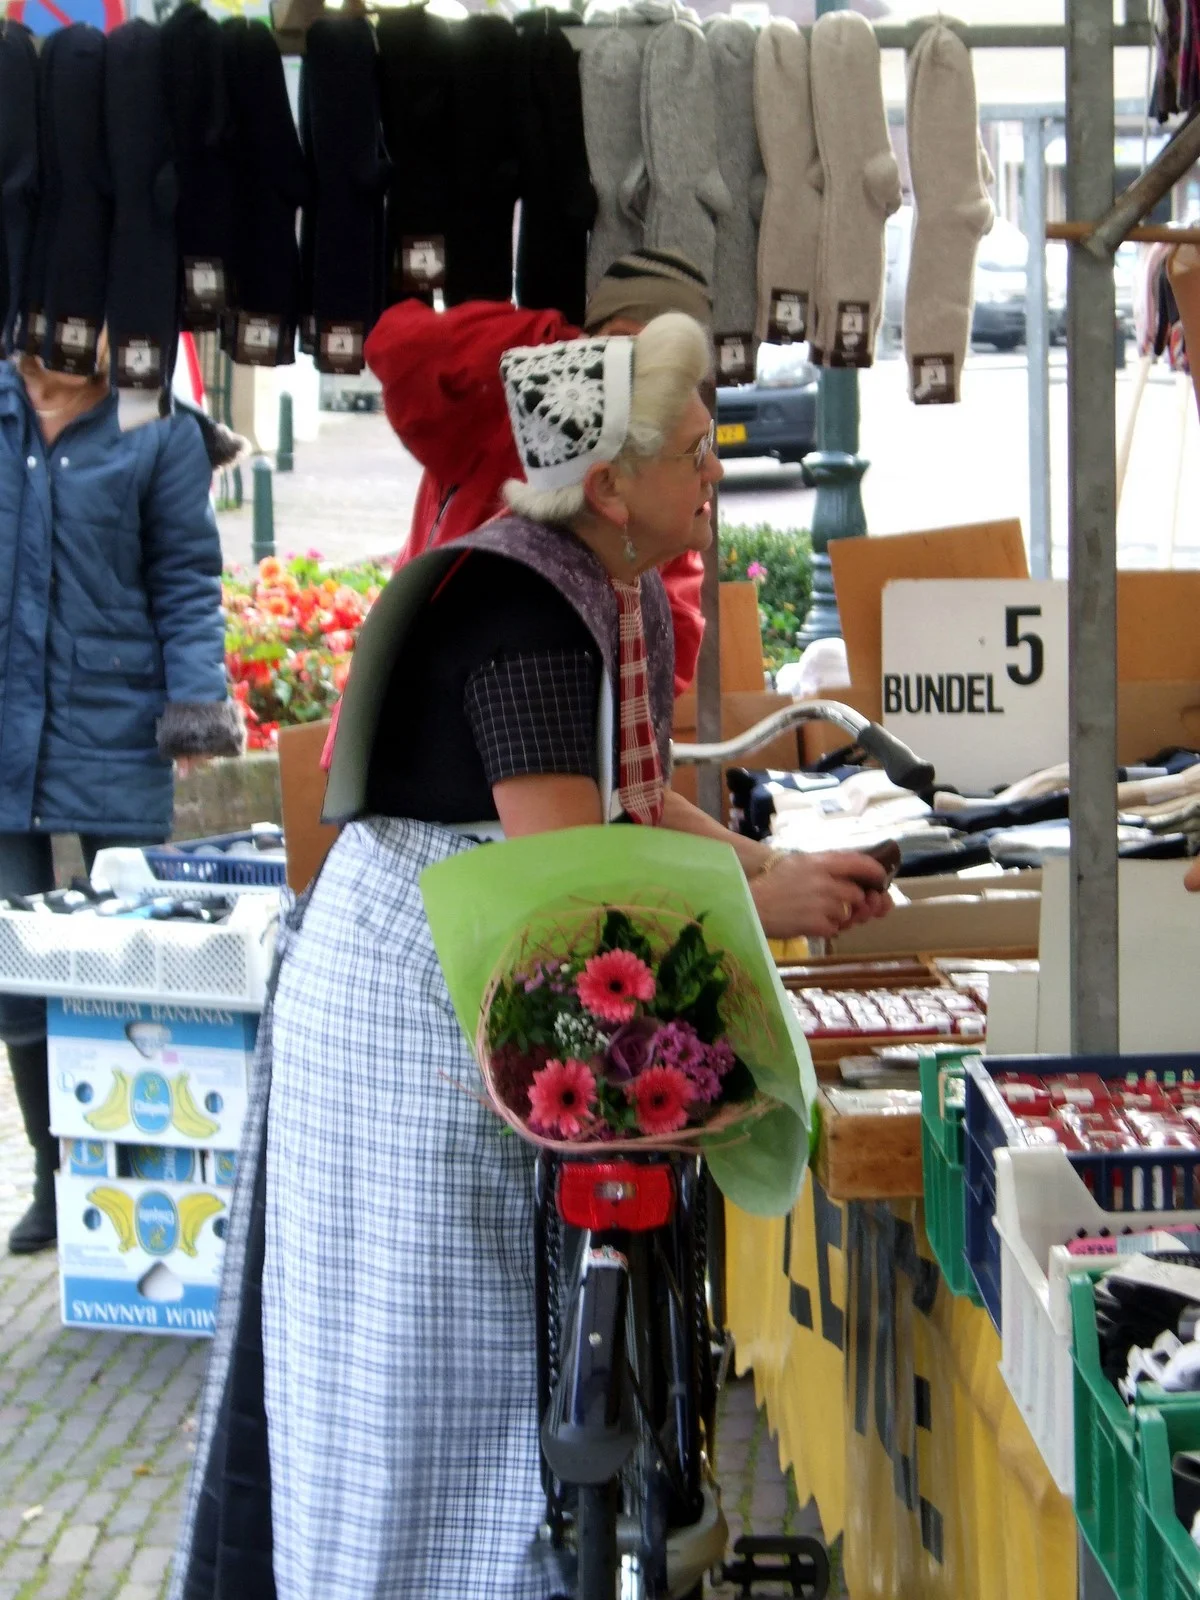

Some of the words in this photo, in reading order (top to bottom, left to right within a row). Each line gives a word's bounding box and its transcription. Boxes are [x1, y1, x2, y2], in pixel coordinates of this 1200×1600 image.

[1005, 605, 1044, 685] 5
[884, 673, 1004, 713] BUNDEL
[62, 998, 142, 1019] PREMIUM
[151, 1005, 234, 1026] BANANAS
[72, 1300, 157, 1325] BANANAS
[165, 1306, 217, 1328] MIUM
